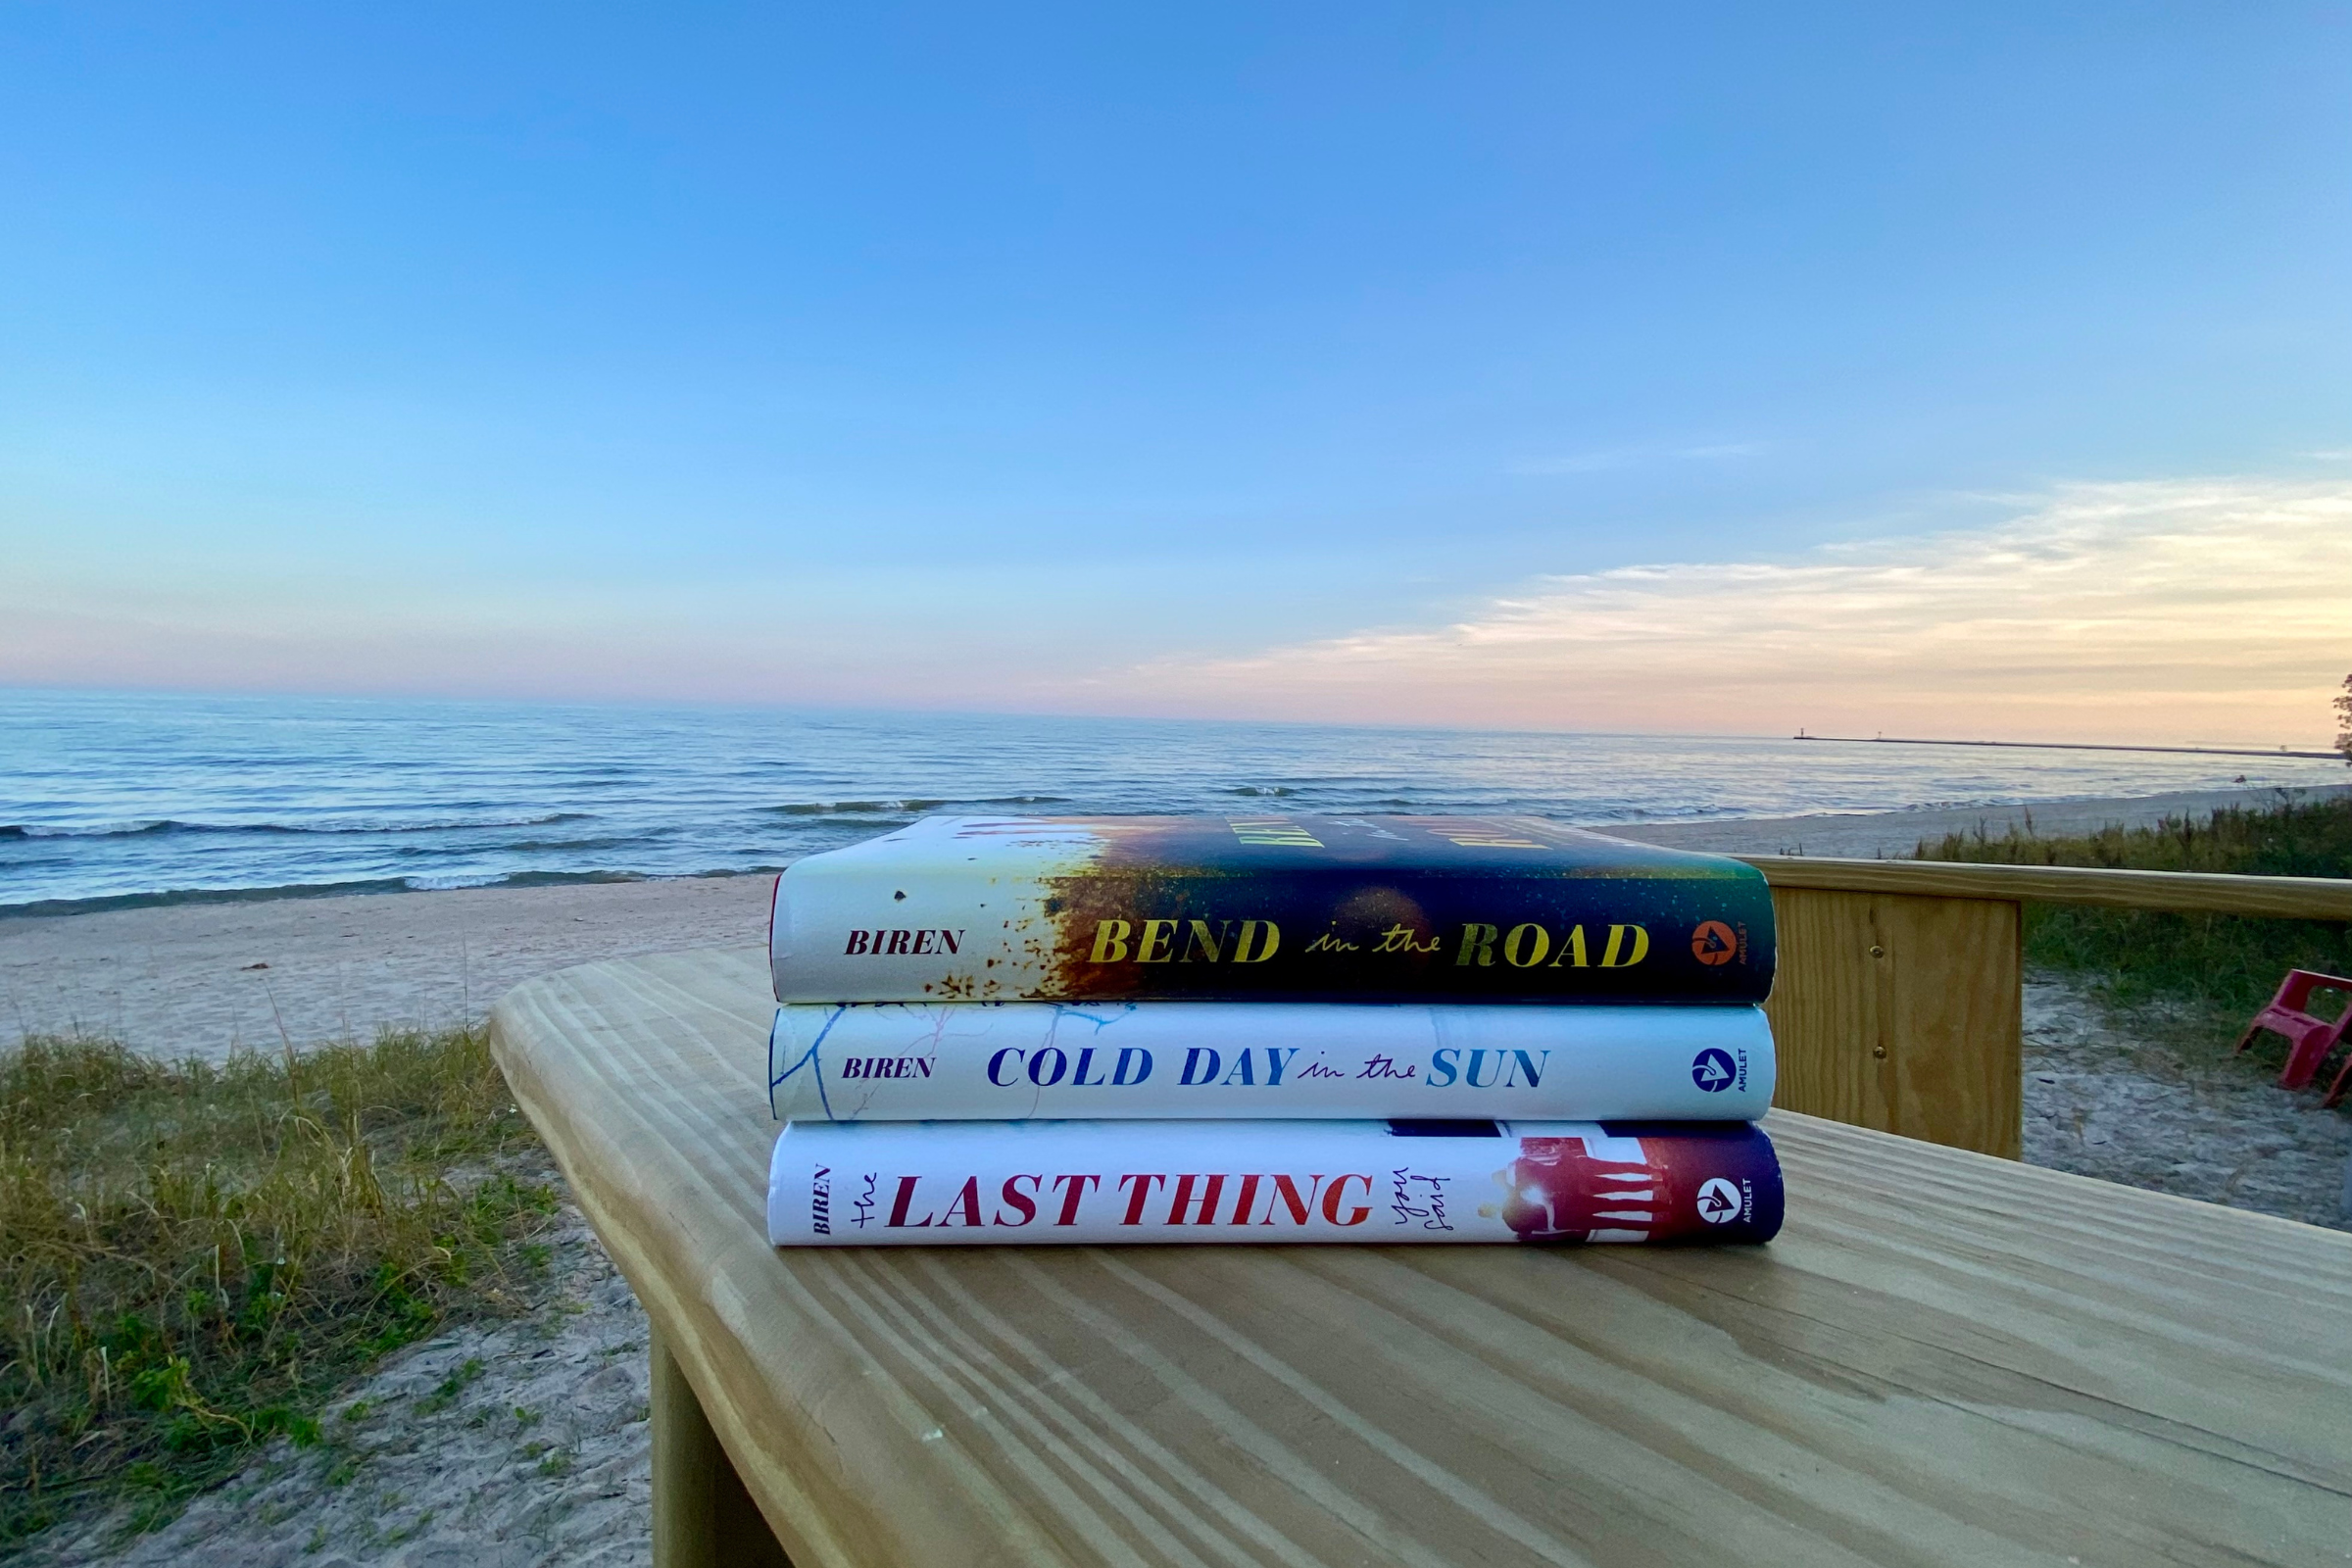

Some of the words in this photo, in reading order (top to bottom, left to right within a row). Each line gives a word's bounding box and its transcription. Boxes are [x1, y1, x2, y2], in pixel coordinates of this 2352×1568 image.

[844, 929, 965, 956] BIREN
[1086, 918, 1281, 964] BEND
[1305, 920, 1359, 954] in
[1371, 922, 1442, 954] the
[1454, 922, 1649, 968] ROAD
[1737, 921, 1748, 965] AMULET
[842, 1056, 936, 1079] BIREN
[986, 1047, 1153, 1087] COLD
[1177, 1047, 1299, 1087] DAY
[1297, 1052, 1346, 1080] in
[1355, 1053, 1417, 1080] the
[1426, 1048, 1551, 1088] SUN
[1738, 1048, 1747, 1093] AMULET
[812, 1163, 832, 1237] BIREN
[851, 1172, 878, 1230] the
[884, 1174, 1102, 1228] LAST
[1118, 1173, 1374, 1228] THING
[1390, 1166, 1416, 1226] you
[1410, 1175, 1454, 1232] said
[1742, 1178, 1753, 1224] AMULET
